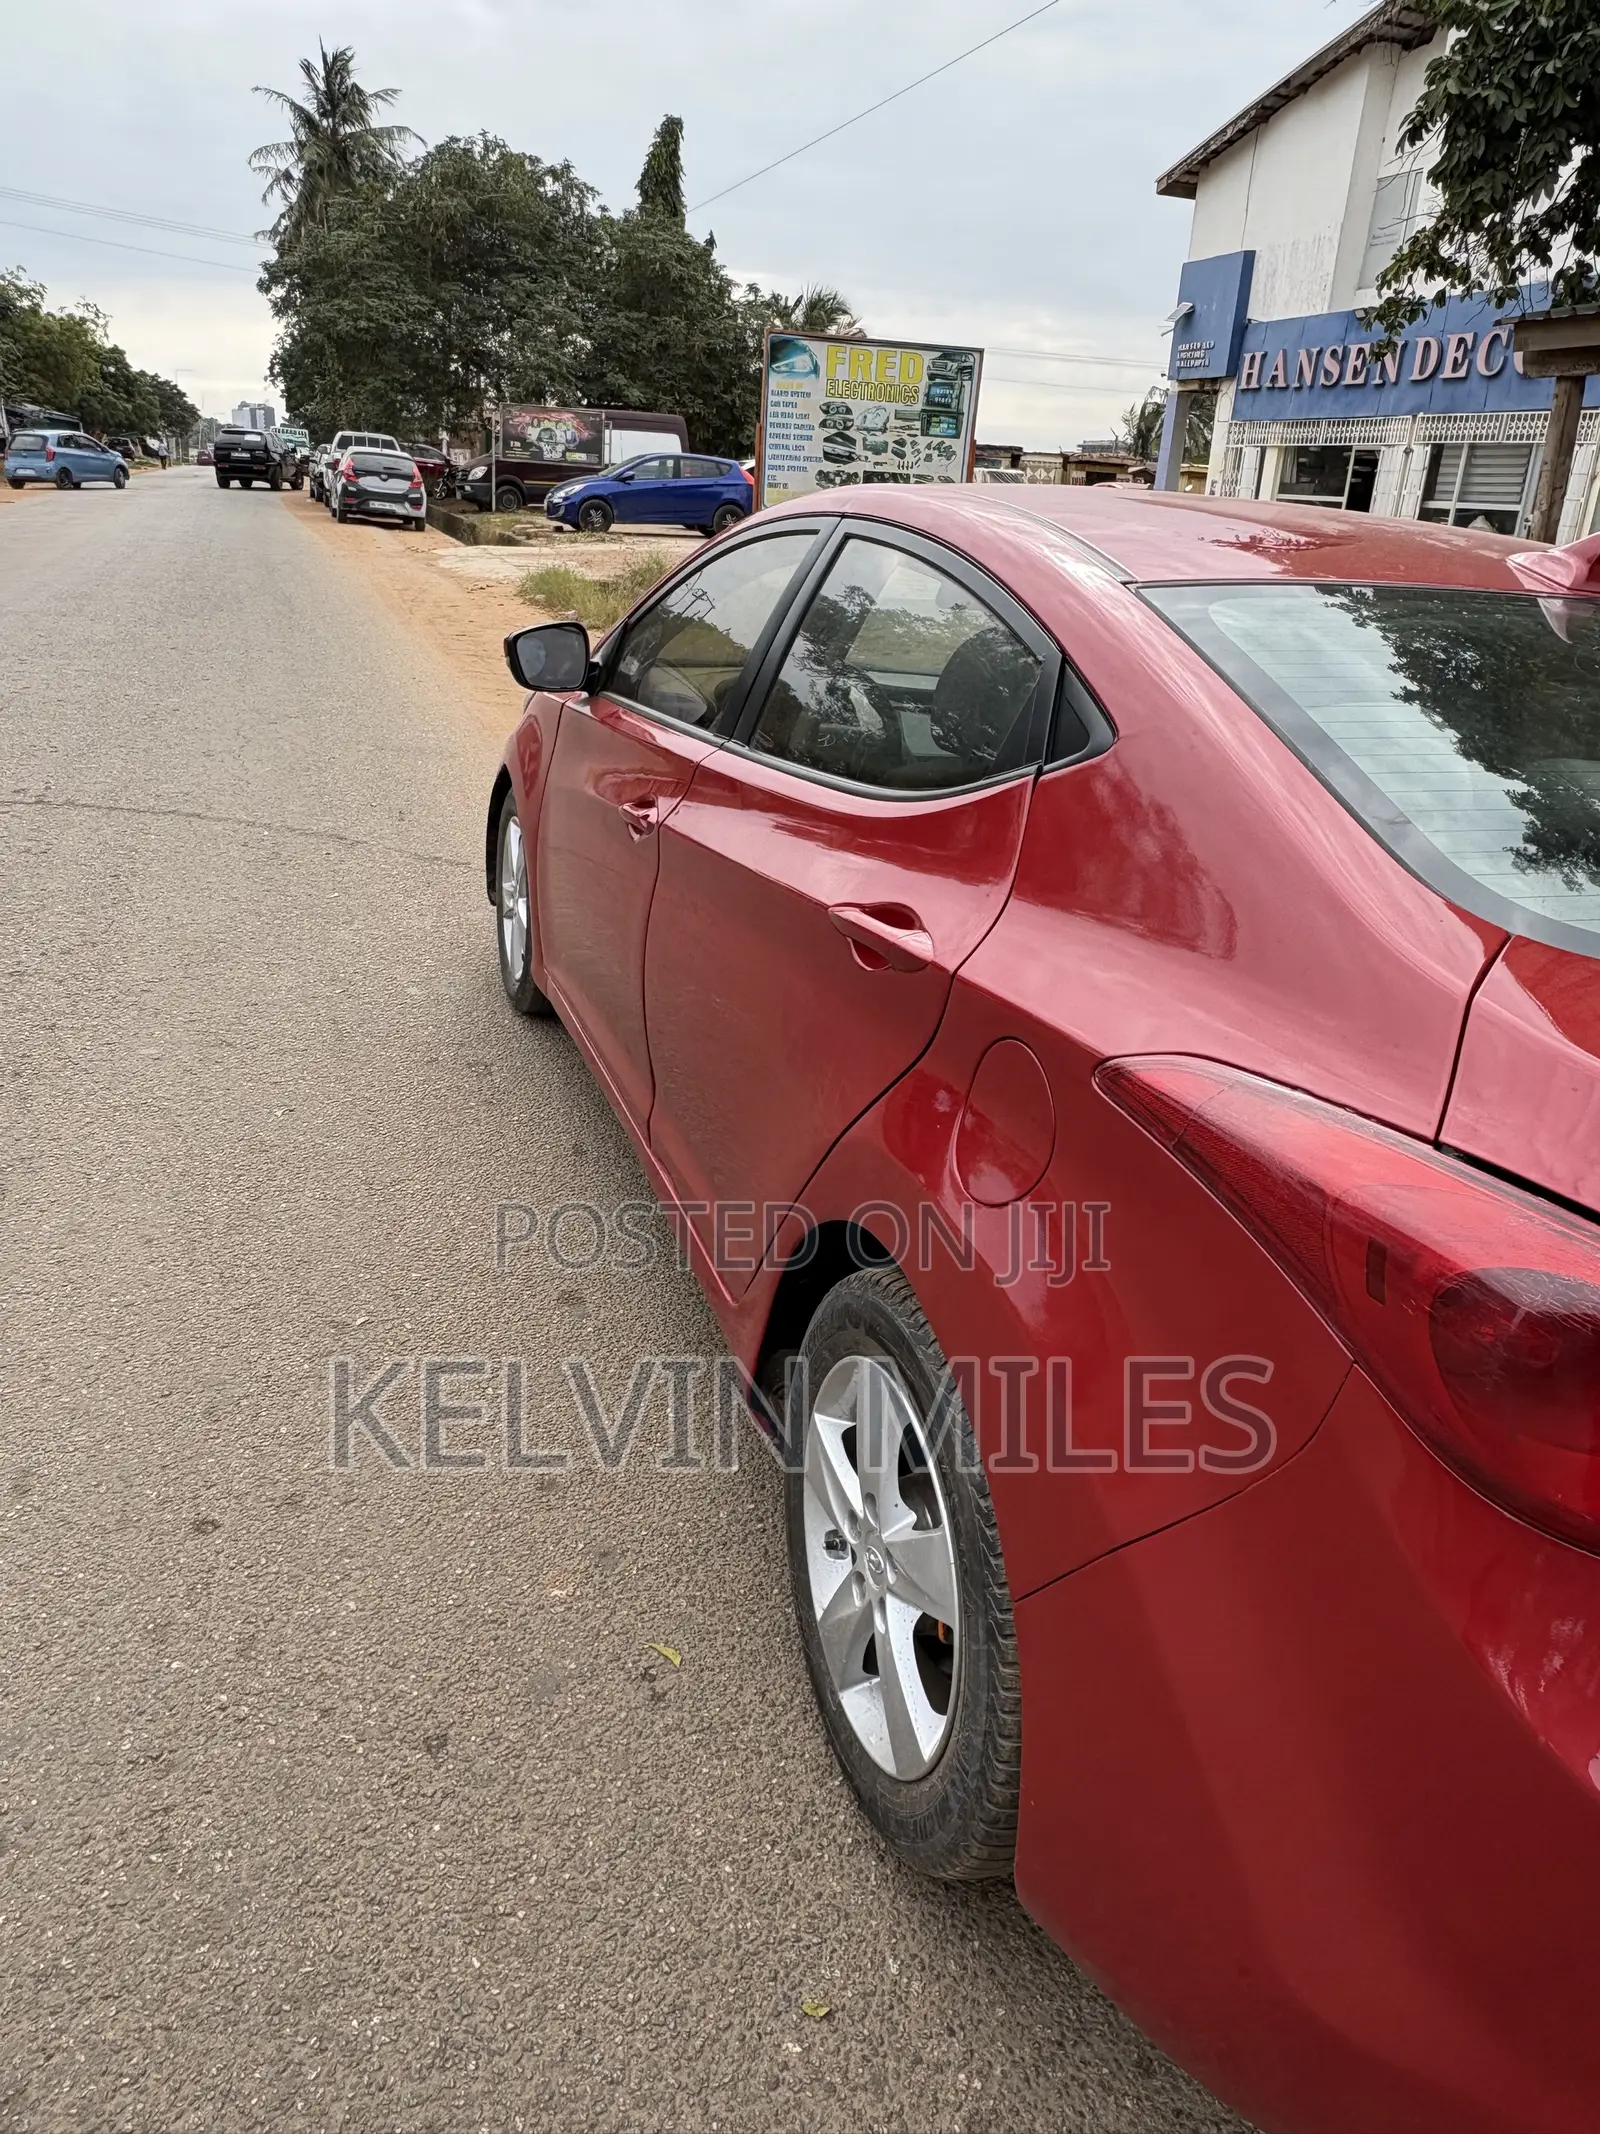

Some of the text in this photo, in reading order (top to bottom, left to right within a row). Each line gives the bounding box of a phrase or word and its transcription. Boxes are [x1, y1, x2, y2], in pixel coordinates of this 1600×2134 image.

[826, 345, 924, 384] FRED
[1238, 324, 1524, 390] HANSEN DEC
[825, 378, 920, 405] ELECTRONICS
